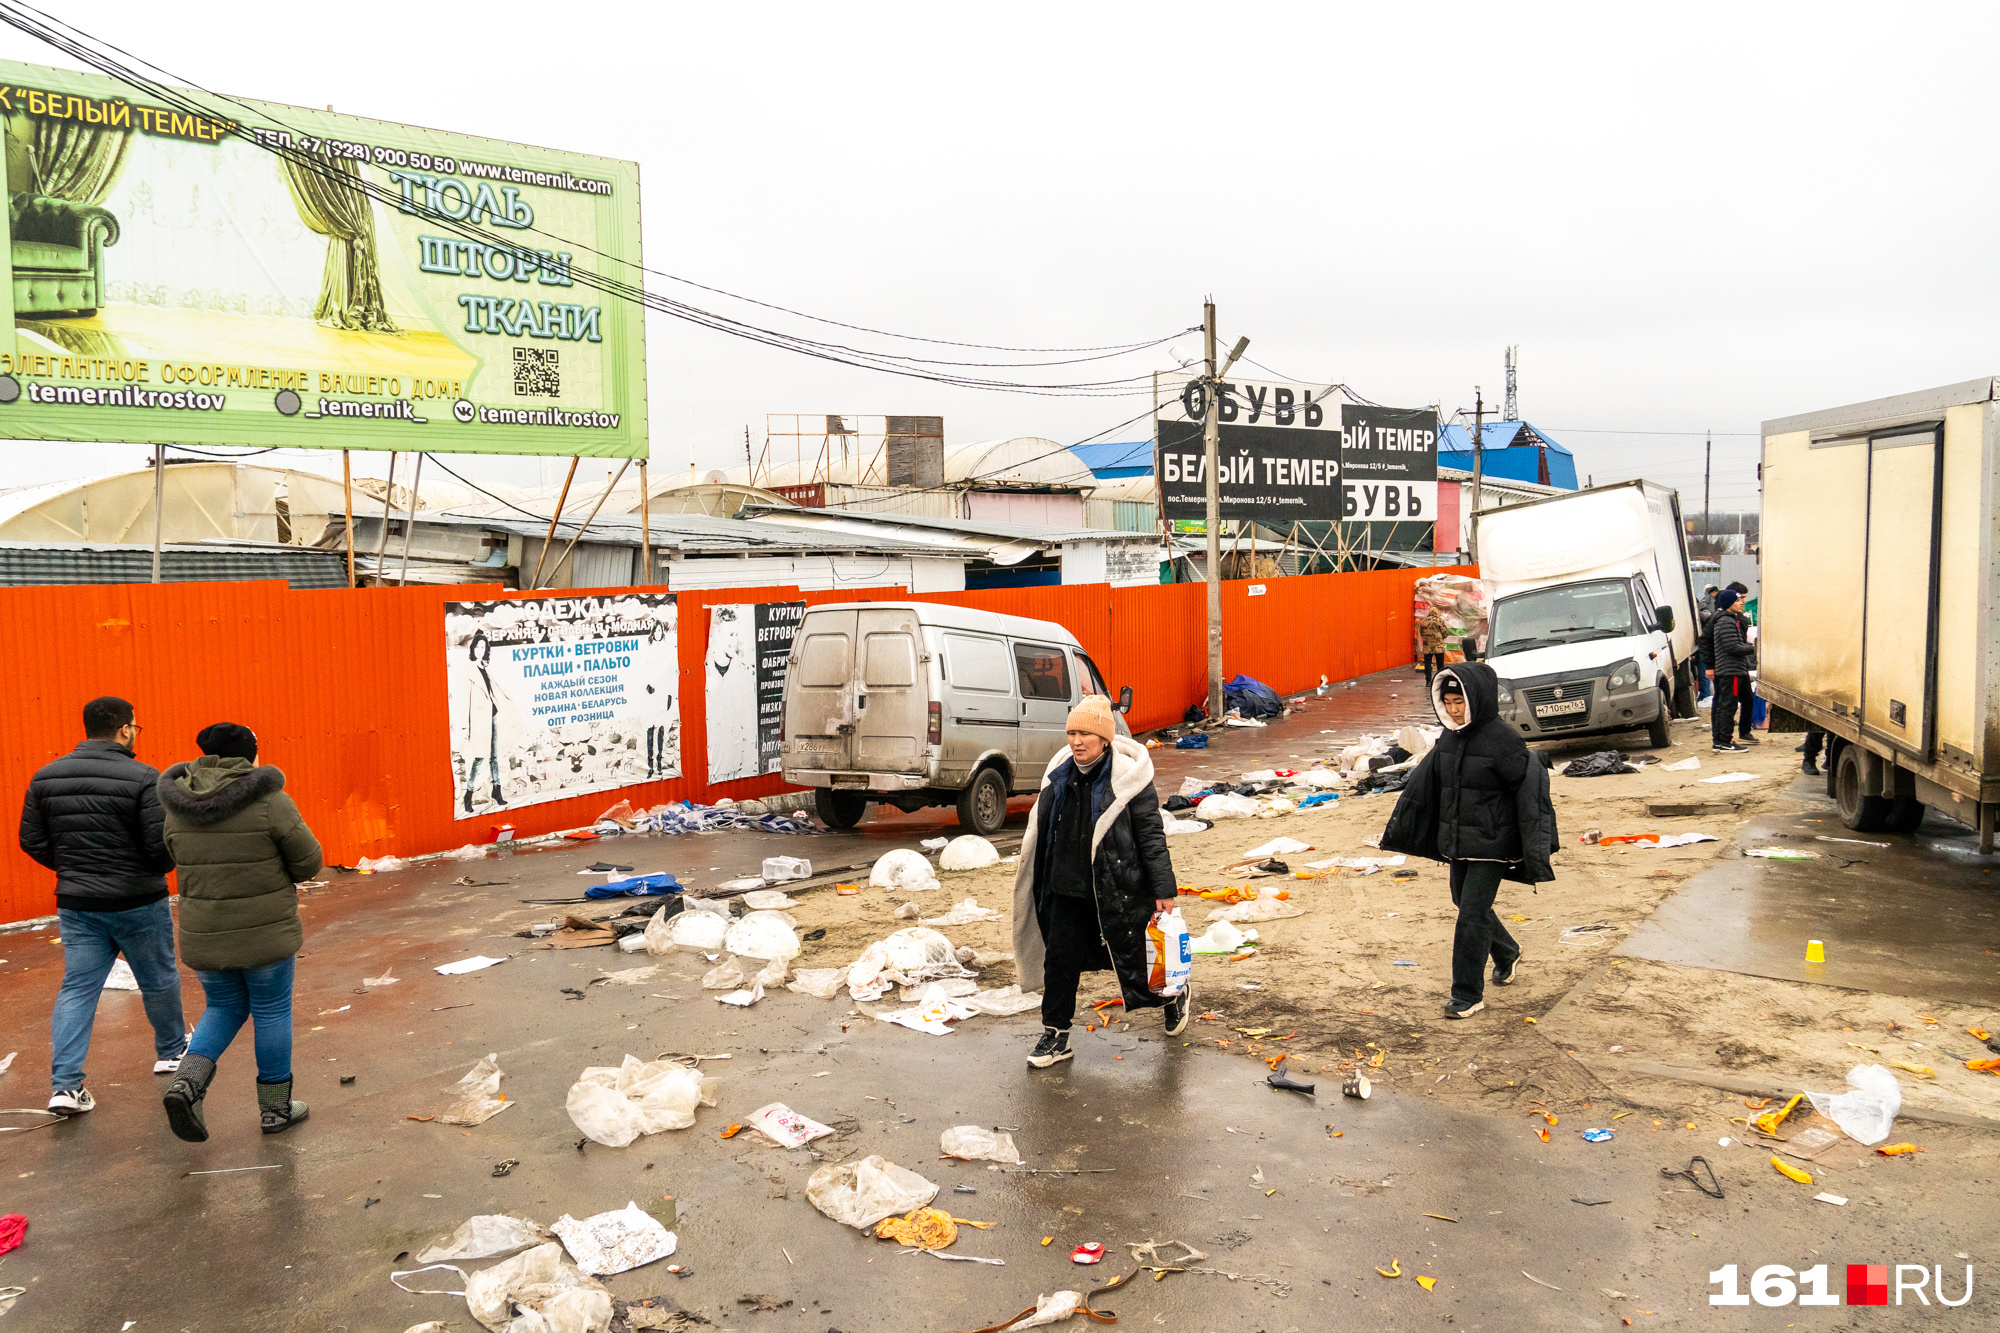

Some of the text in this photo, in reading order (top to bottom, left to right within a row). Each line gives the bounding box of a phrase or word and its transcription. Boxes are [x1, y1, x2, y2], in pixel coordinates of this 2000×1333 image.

[300, 137, 321, 153] +7
[325, 139, 371, 163] (928)
[374, 146, 407, 166] 900
[410, 153, 431, 171] 50
[434, 157, 455, 175] 50
[458, 160, 612, 196] www.temernik.com
[391, 171, 533, 229] ТЮЛЬ
[419, 235, 574, 287] ШТОРЫ
[459, 295, 602, 342] ТКАНИ
[1, 352, 464, 399] ЭЛЕГАНТНОЕ ОФОРМЛЕНИЕ ВАШЕГО ДОМА
[28, 382, 225, 411] temernikrostov
[1184, 379, 1323, 428] ОБУВЬ
[305, 398, 428, 423] _temernik_
[479, 407, 621, 429] temernikrostov
[1375, 427, 1435, 452] ТЕМЕР
[1262, 457, 1339, 486] ТЕМЕР
[1256, 496, 1272, 505] 12/5
[524, 598, 616, 621] ОДЕЖДА
[484, 626, 539, 641] ВЕРХНЯЯ
[611, 619, 654, 633] МОДНАЯ
[512, 639, 639, 662] КУРТКИ ВЕТРОВКИ
[523, 656, 631, 678] ПЛАЩИ ПАЛЬТО
[534, 684, 625, 702] НОВАЯ КОЛЛЕКЦИЯ
[541, 674, 618, 690] КАЖДЫЙ СЕЗОН
[532, 697, 628, 716] УКРАИНА БЕЛАРУСЬ
[547, 710, 615, 727] ОПТ РОЗНИЦА
